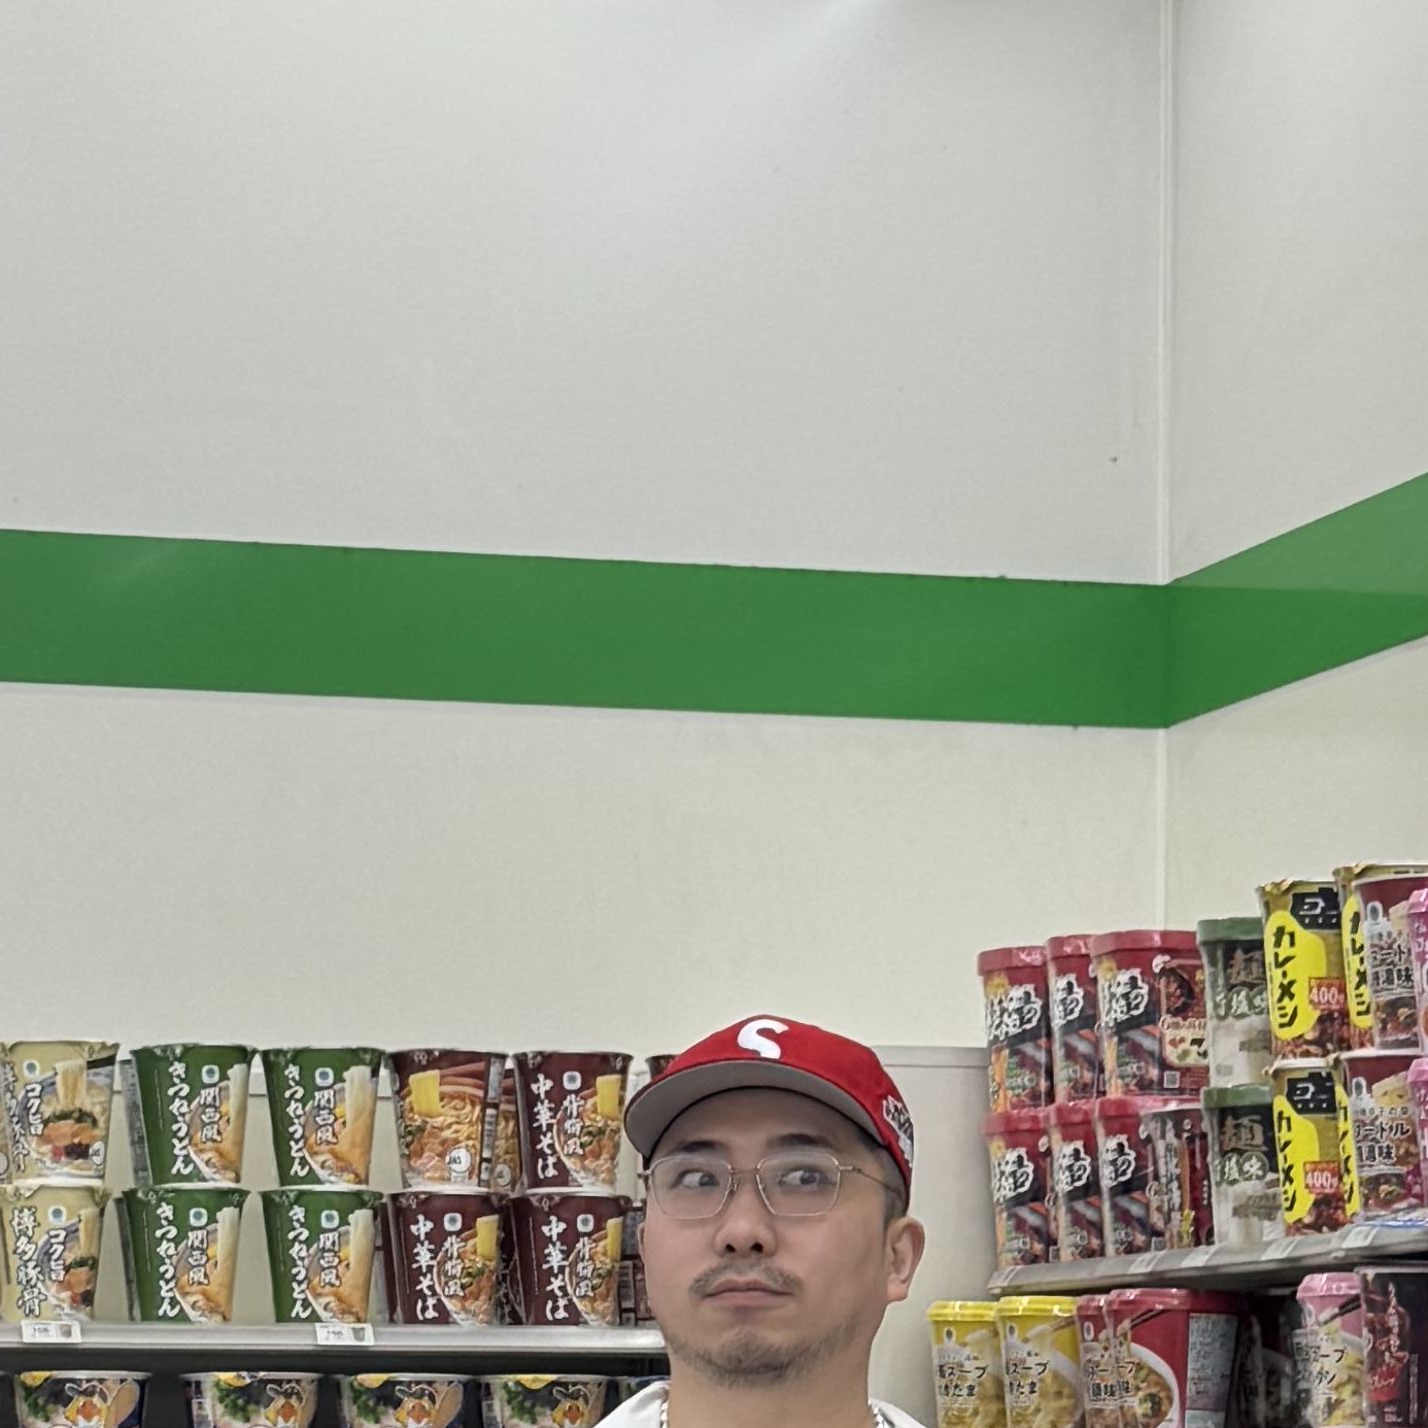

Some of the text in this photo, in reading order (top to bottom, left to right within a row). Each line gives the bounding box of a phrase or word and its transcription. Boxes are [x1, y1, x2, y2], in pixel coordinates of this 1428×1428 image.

[737, 1019, 789, 1059] S
[168, 1056, 193, 1177] きつねうどん
[198, 1084, 223, 1147] 関西風
[281, 1061, 310, 1177] きつねうどん
[530, 1073, 555, 1179] 中華そば
[12, 1204, 46, 1320] 博多豚骨
[154, 1200, 181, 1321] きつねうどん
[316, 1226, 342, 1289] 関西風
[410, 1213, 439, 1321] 中華そば
[541, 1216, 569, 1321] 中華そば
